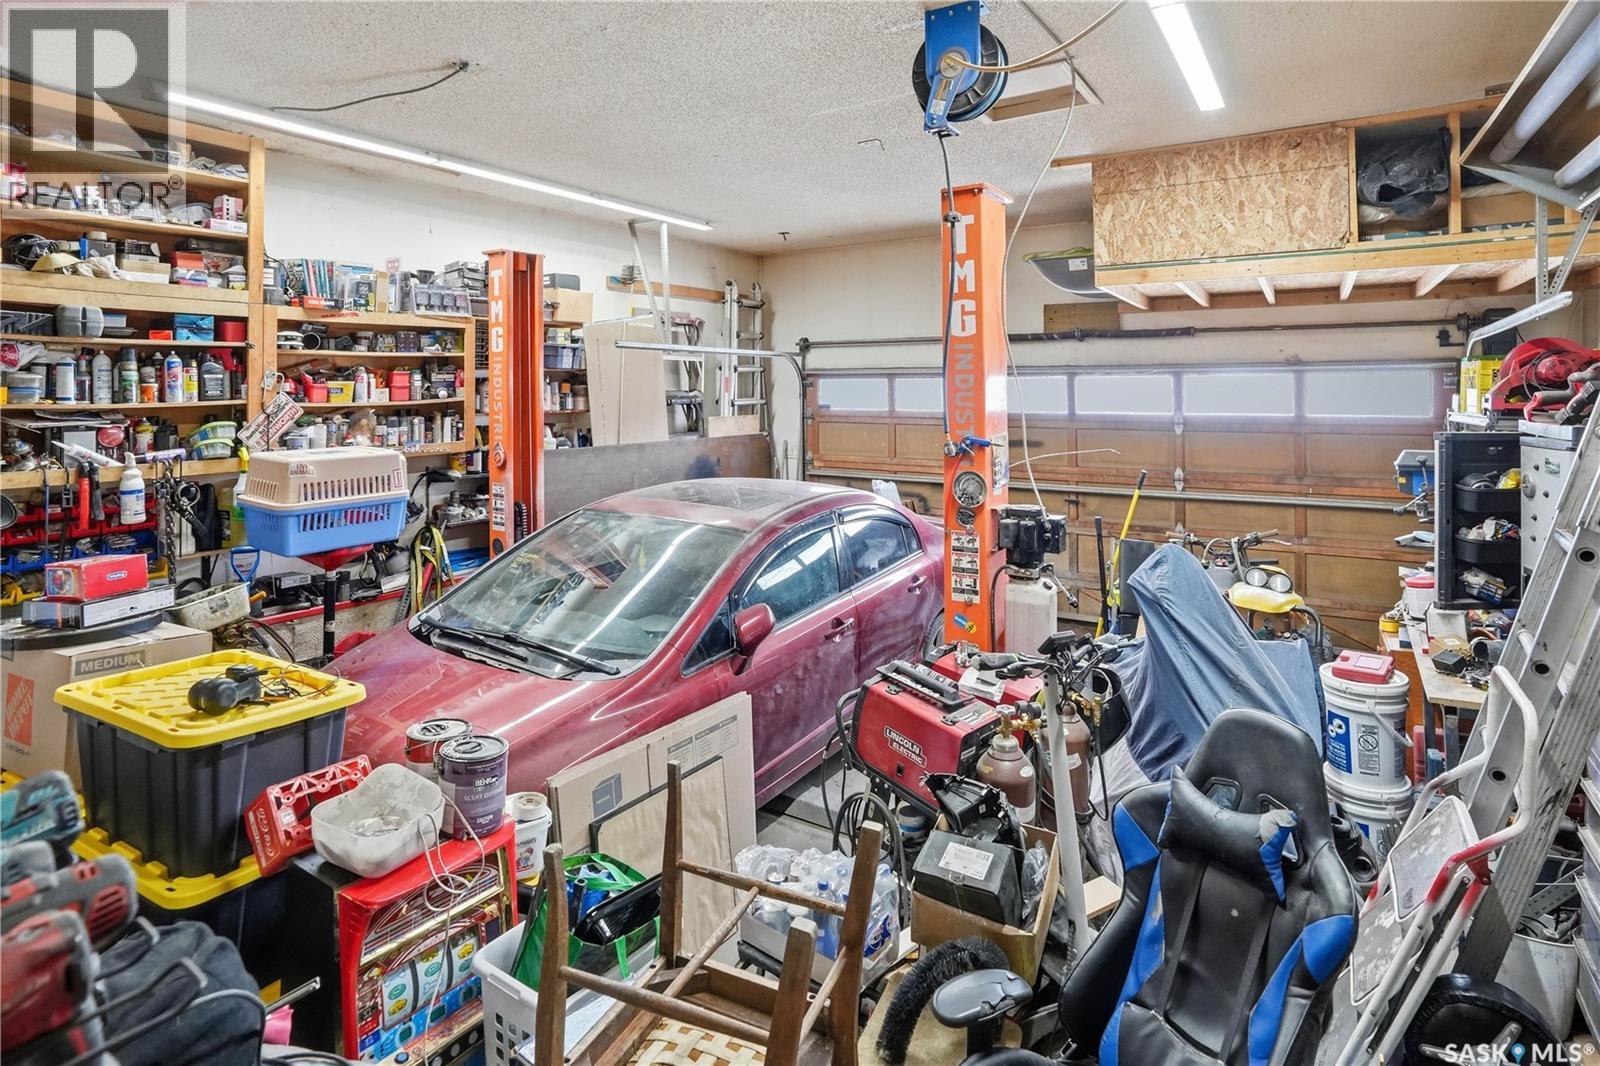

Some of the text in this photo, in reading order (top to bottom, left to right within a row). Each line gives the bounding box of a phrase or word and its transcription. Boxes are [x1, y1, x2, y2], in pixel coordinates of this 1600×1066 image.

[949, 215, 977, 337] TMG
[490, 268, 504, 353] TMG
[80, 653, 140, 673] MEDIUM
[886, 728, 920, 754] LINCOLN
[892, 742, 923, 764] ELECTRIC
